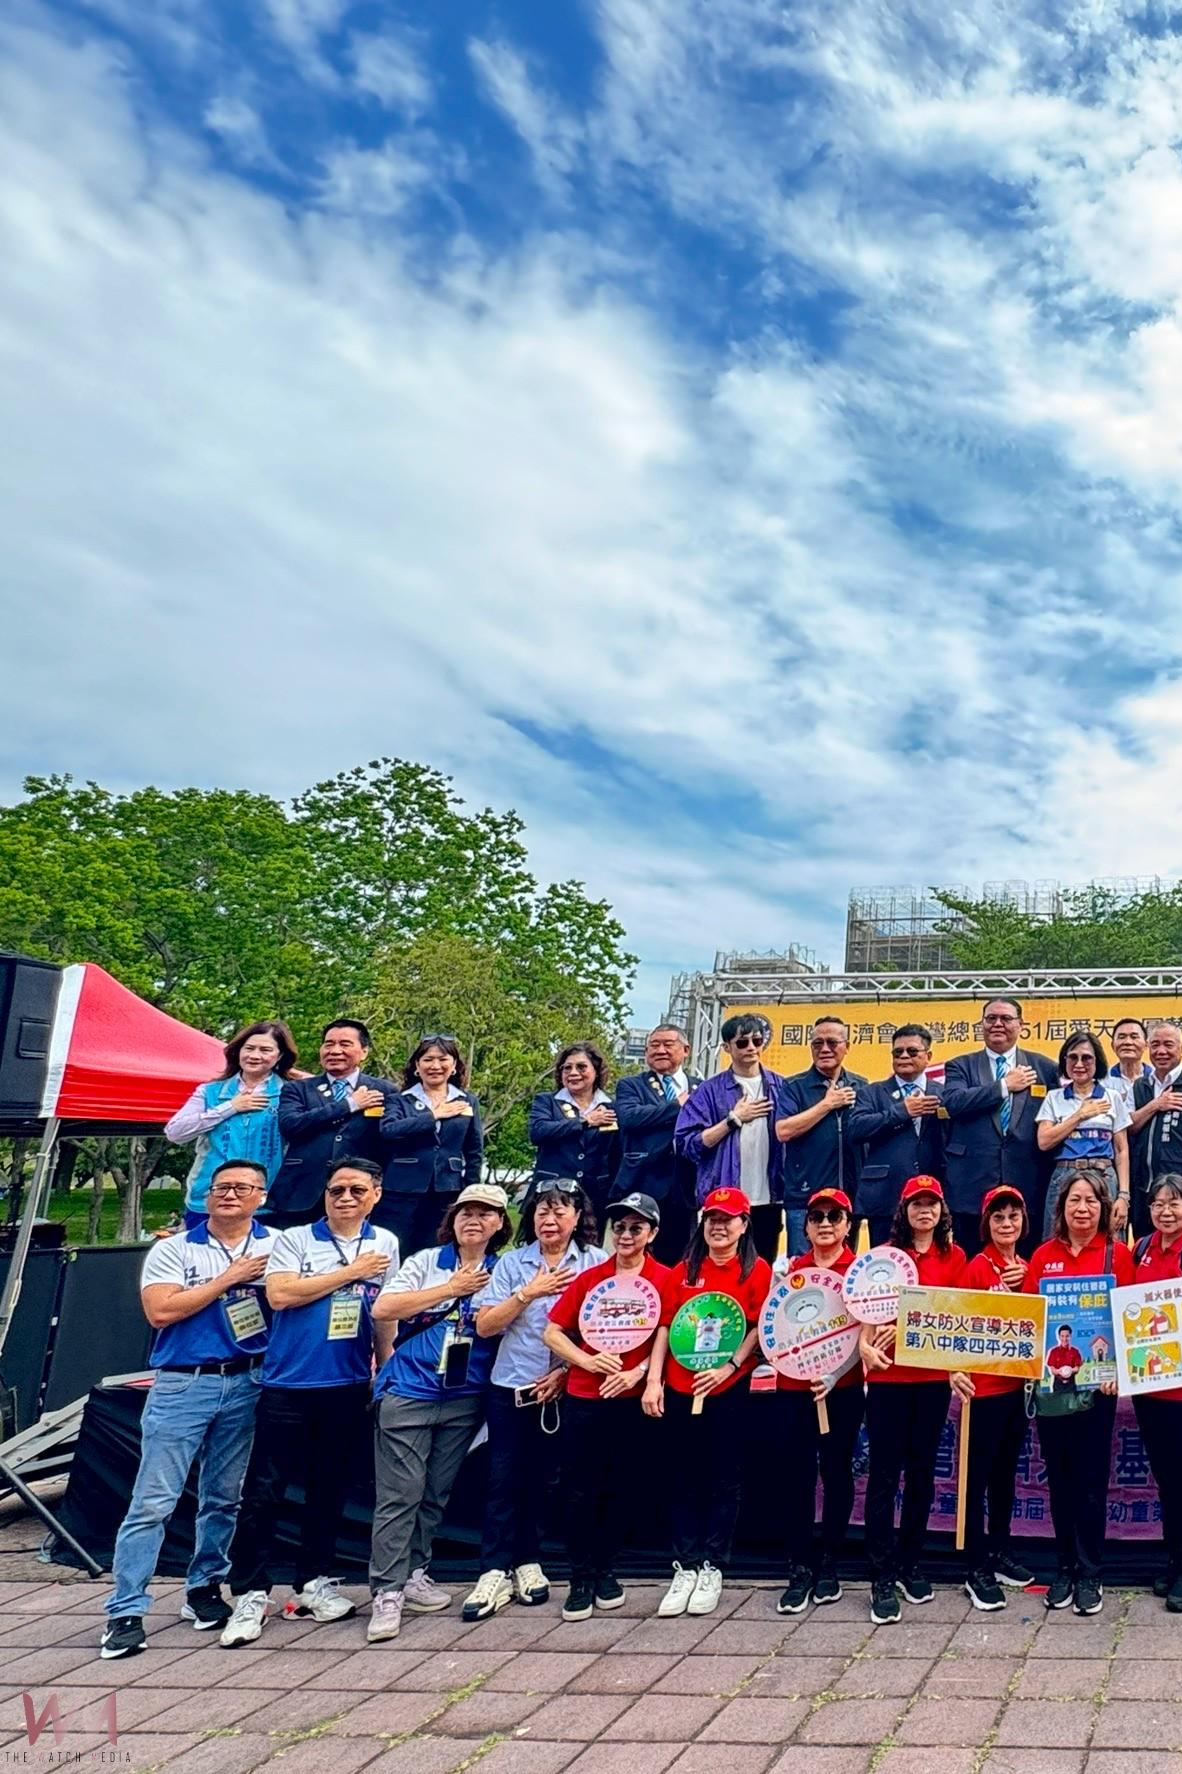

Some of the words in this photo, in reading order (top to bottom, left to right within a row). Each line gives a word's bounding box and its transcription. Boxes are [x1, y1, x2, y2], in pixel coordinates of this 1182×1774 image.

[906, 1310, 1036, 1338] 婦女防火宣導大隊
[905, 1331, 1034, 1359] 第八中隊四平分隊
